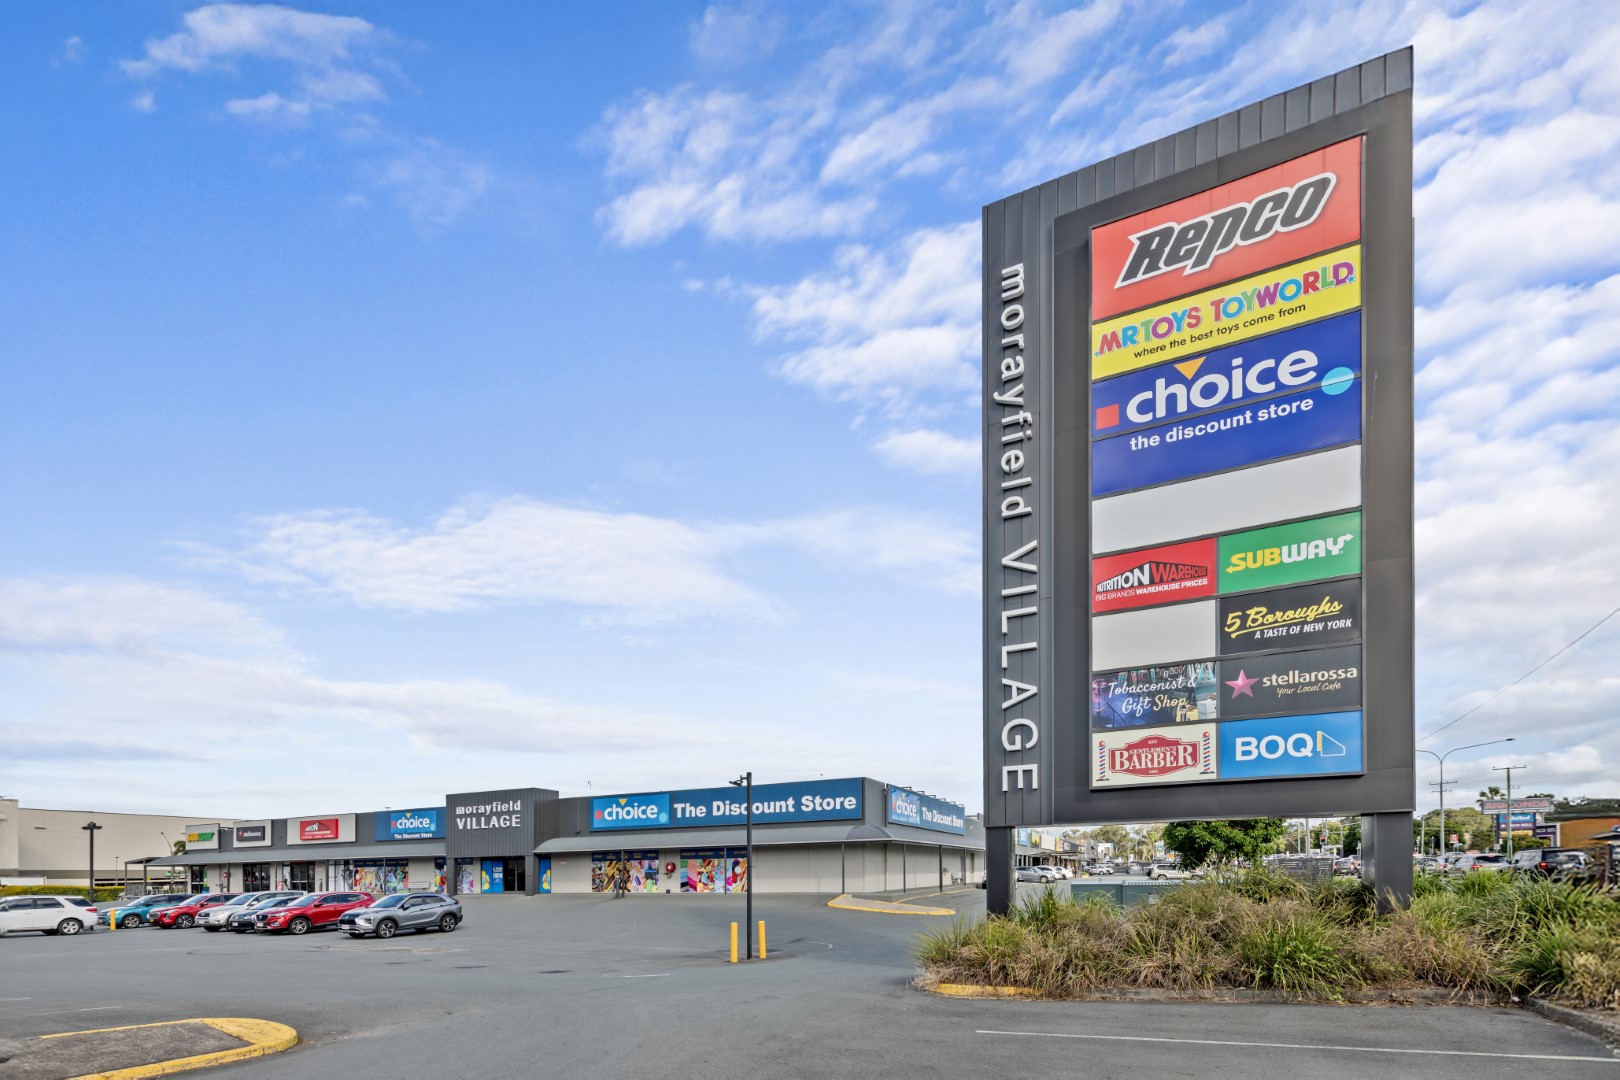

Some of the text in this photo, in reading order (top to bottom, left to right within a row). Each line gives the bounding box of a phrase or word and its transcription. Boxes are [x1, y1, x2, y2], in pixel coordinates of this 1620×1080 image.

[1114, 171, 1337, 289] Repco
[1210, 261, 1354, 322] TOYWORLD
[1134, 303, 1306, 358] where the best toys come from
[993, 263, 1032, 520] morayfield
[1126, 350, 1319, 423] choice
[1130, 398, 1314, 450] the discount store
[1225, 533, 1354, 573] SUBWAY
[1095, 578, 1208, 601] BIG BRANDS WAREHOUSE PRICES
[1097, 562, 1208, 593] NUTRITION WAREHOUSE
[1224, 596, 1343, 632] 5 Boroughs
[1254, 618, 1352, 639] A TASTE OF NEW YORK
[1001, 540, 1038, 792] VILLAGE
[1262, 667, 1357, 687] stellarossa
[1108, 676, 1198, 698] Tobacconist &
[1297, 683, 1321, 693] Local
[1121, 694, 1189, 717] Gift Shop
[1114, 744, 1195, 771] BARBER
[1236, 733, 1314, 761] BOQ
[456, 800, 521, 816] morayfield
[604, 795, 857, 821] choice The Discount Store
[896, 797, 917, 817] choice
[922, 806, 932, 821] The
[397, 816, 430, 829] choice
[456, 814, 521, 830] VILLAGE
